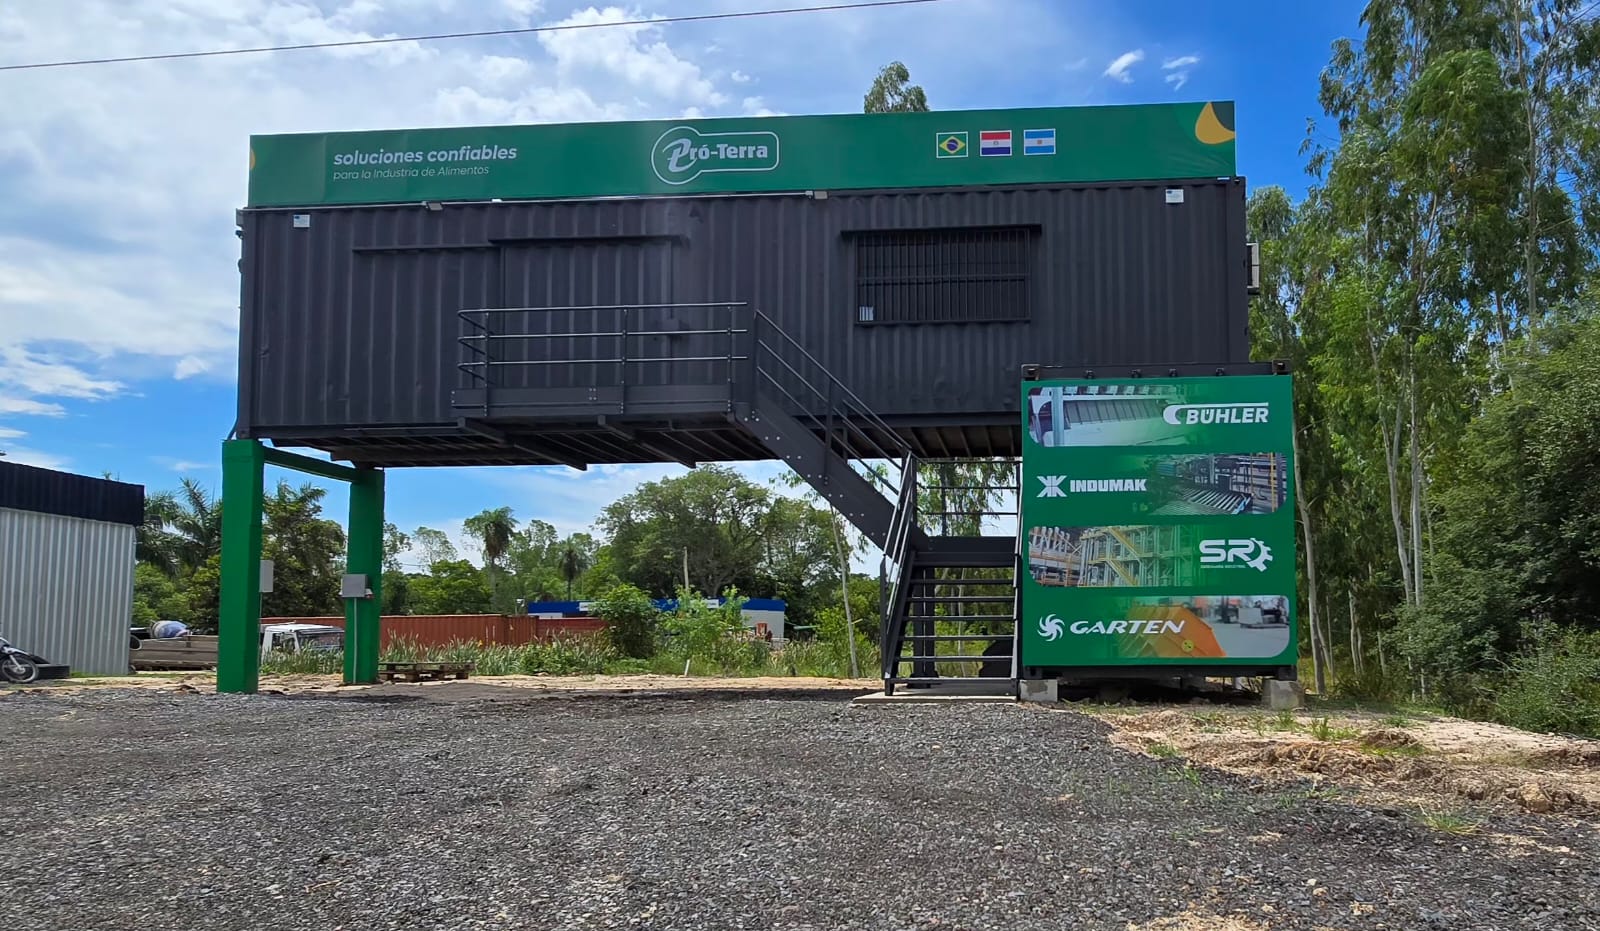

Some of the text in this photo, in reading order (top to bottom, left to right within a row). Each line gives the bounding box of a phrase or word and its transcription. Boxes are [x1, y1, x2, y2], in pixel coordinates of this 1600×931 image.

[333, 145, 518, 165] soluciones confiables
[662, 138, 768, 172] Pró-Terra
[333, 165, 490, 180] para la Industria de Alimentos
[1185, 407, 1269, 425] BÜHLER
[1070, 479, 1147, 492] INDUMAK
[1199, 539, 1255, 562] SR
[1070, 620, 1186, 634] GARTEN
